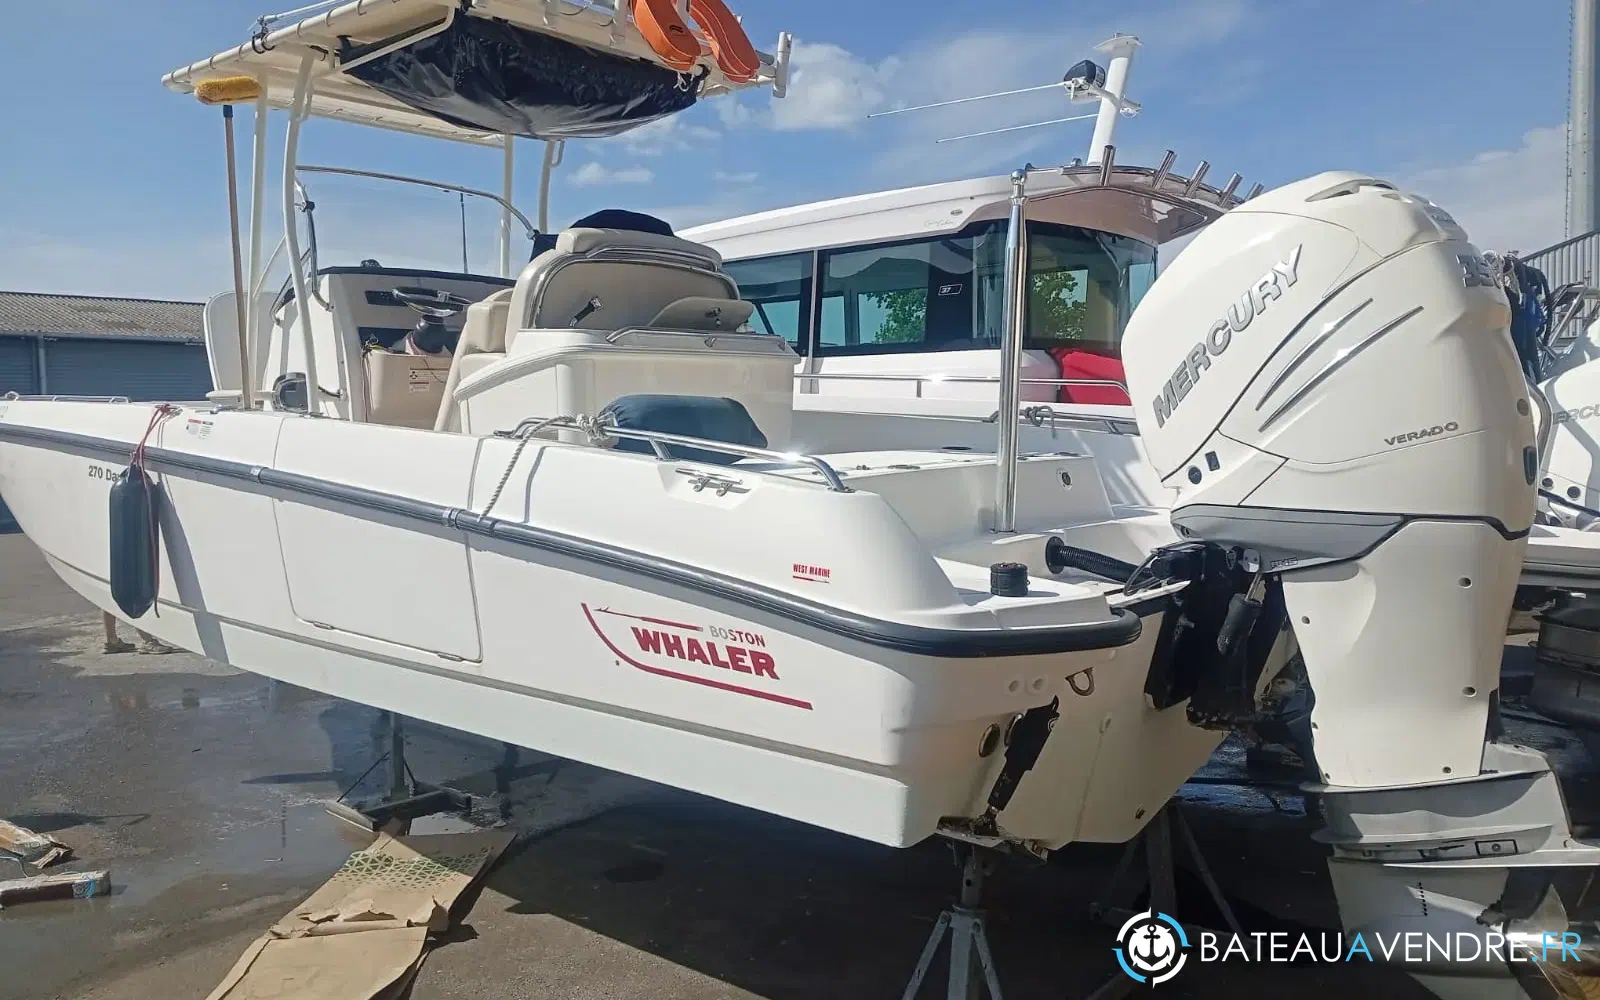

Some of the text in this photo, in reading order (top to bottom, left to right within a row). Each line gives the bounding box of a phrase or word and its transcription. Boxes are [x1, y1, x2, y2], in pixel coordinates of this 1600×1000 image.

[1152, 243, 1303, 429] MERCURY
[1384, 421, 1459, 446] VERADO
[88, 465, 103, 479] 270
[793, 564, 830, 578] WEST MARINE
[710, 625, 766, 648] BOSTON
[631, 626, 780, 680] WHALER
